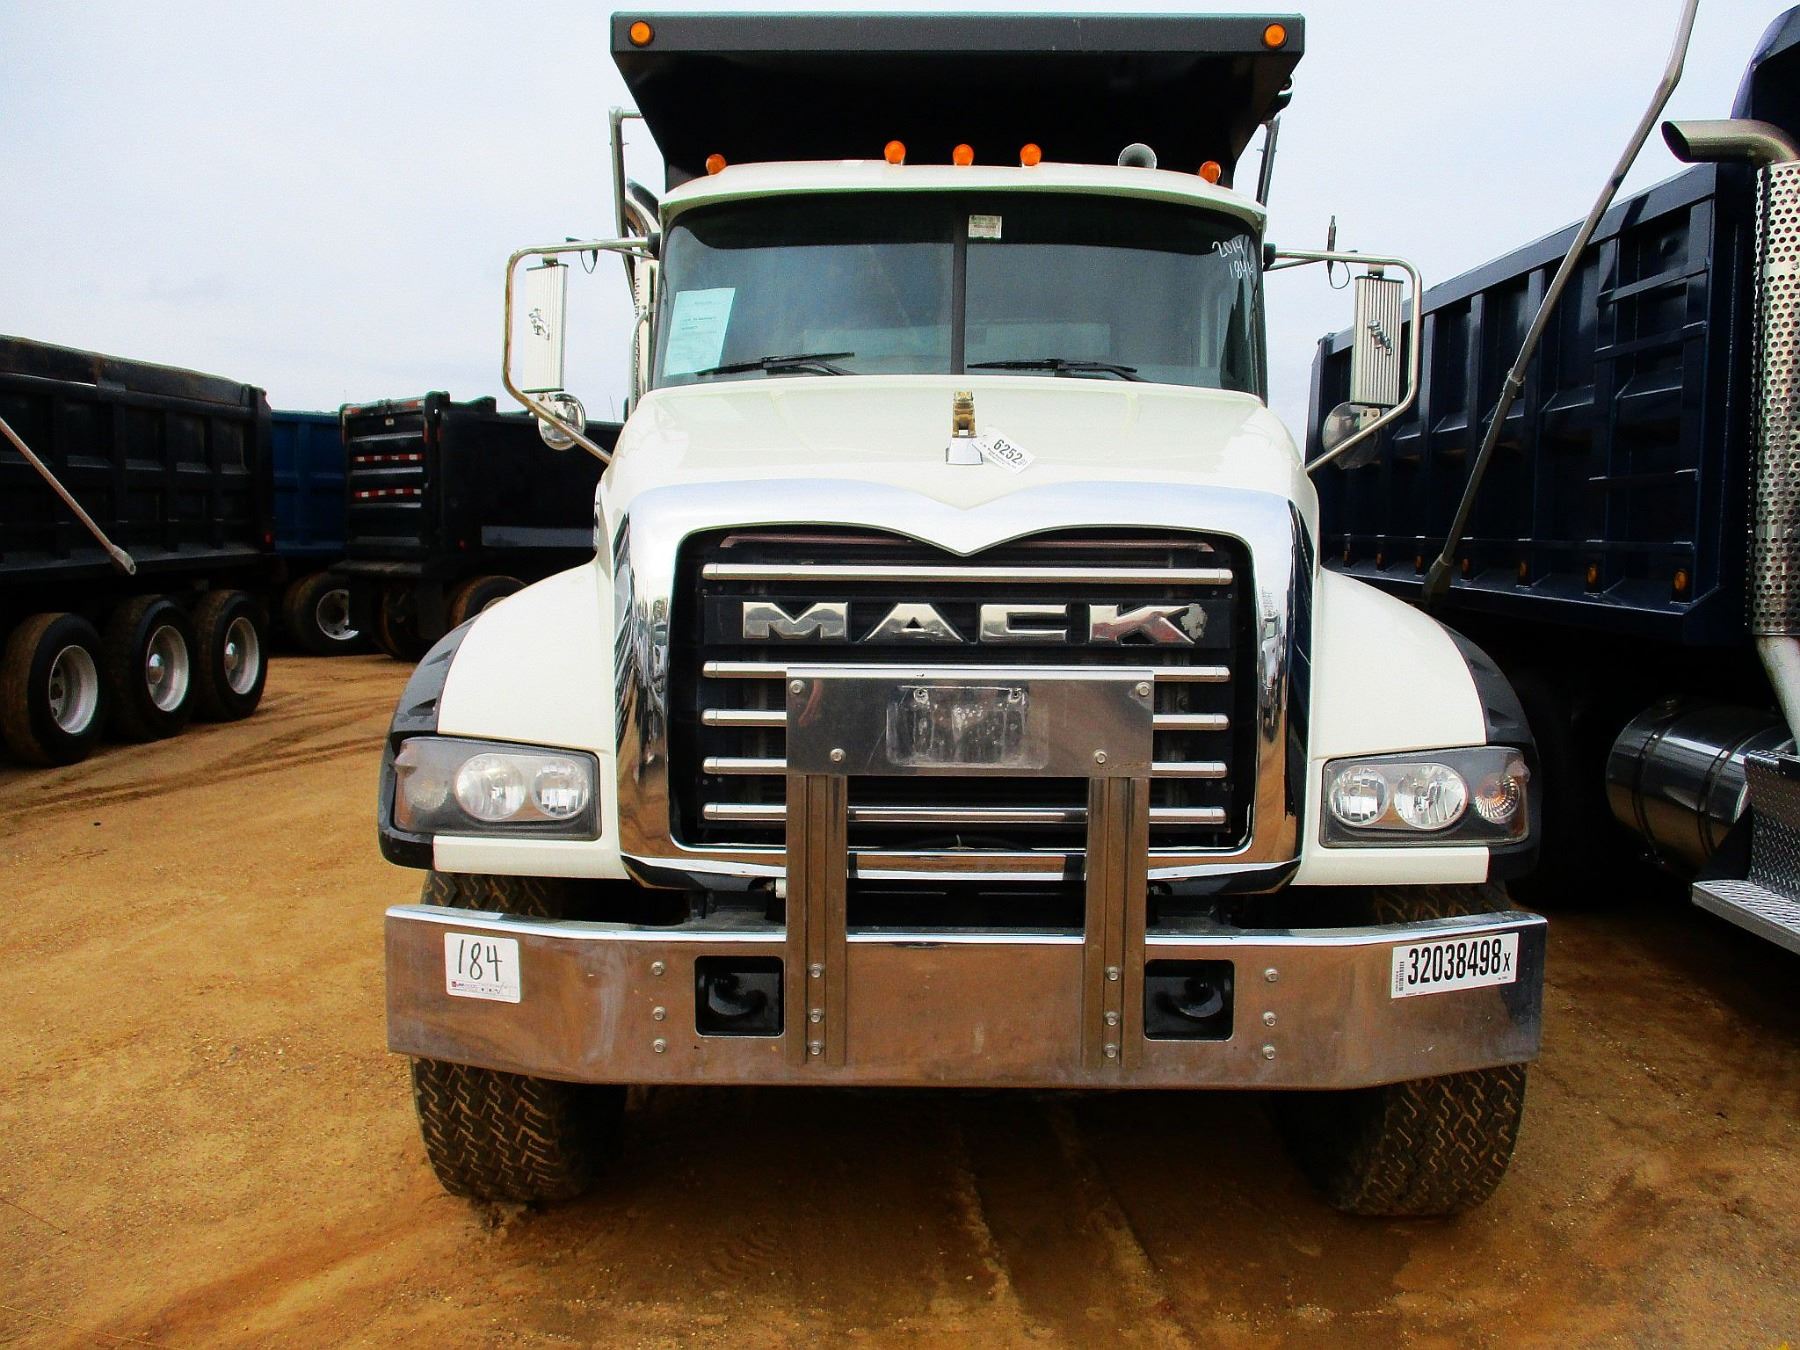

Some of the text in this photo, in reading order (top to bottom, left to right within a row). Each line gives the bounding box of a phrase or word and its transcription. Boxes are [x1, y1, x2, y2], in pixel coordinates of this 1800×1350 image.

[1212, 239, 1244, 257] 2014
[993, 439, 1023, 464] 6252
[743, 601, 1196, 645] MACK
[458, 939, 503, 982] 184
